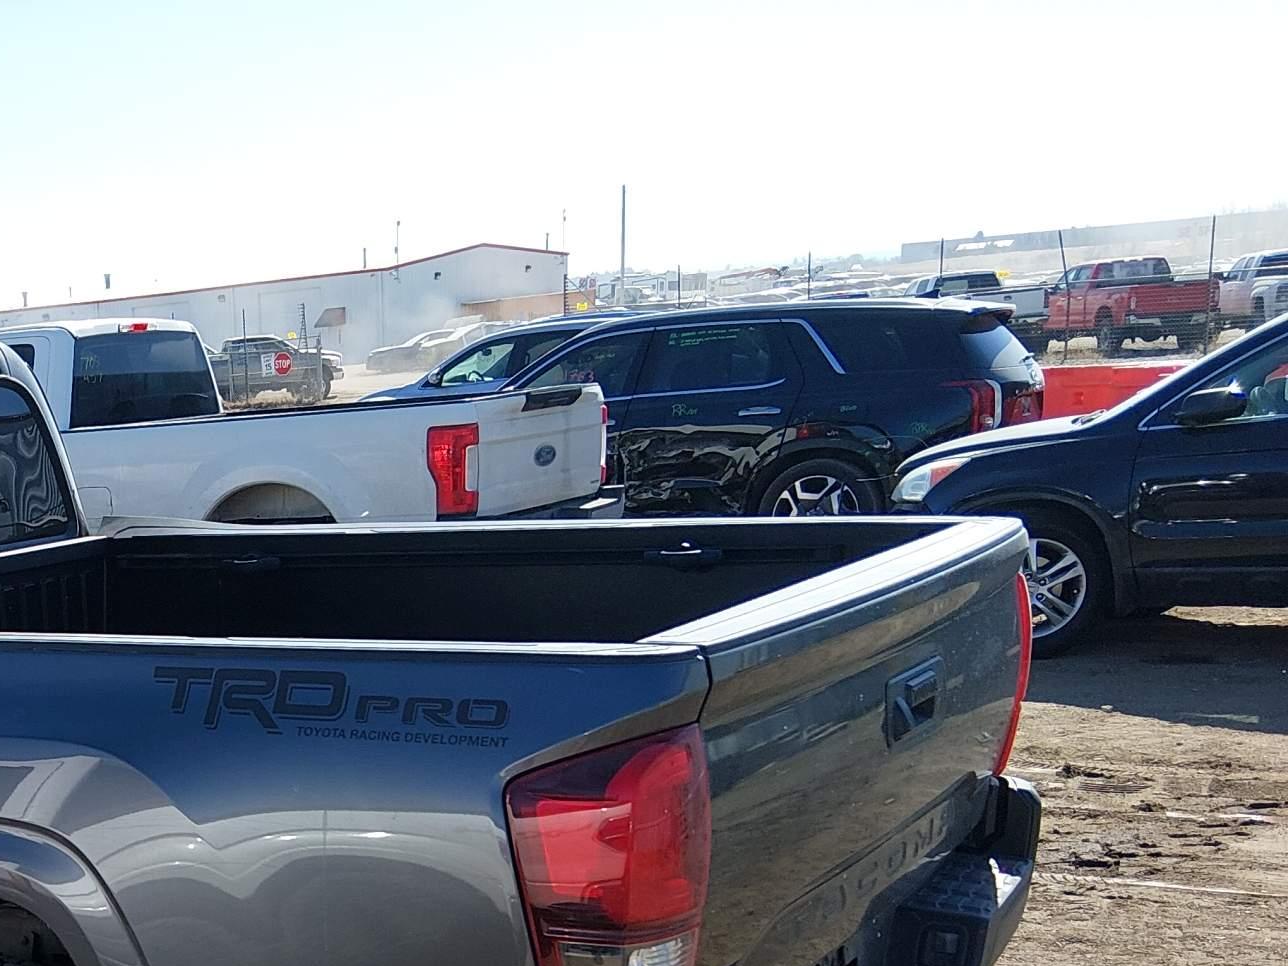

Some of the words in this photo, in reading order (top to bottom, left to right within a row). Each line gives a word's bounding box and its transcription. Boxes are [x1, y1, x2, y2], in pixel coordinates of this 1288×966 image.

[275, 359, 291, 369] STOP
[153, 665, 351, 735] TRD
[354, 694, 512, 730] PRO
[296, 725, 348, 741] TOYOTA
[350, 729, 401, 744] RACING
[404, 732, 510, 749] DEVELOPMENT
